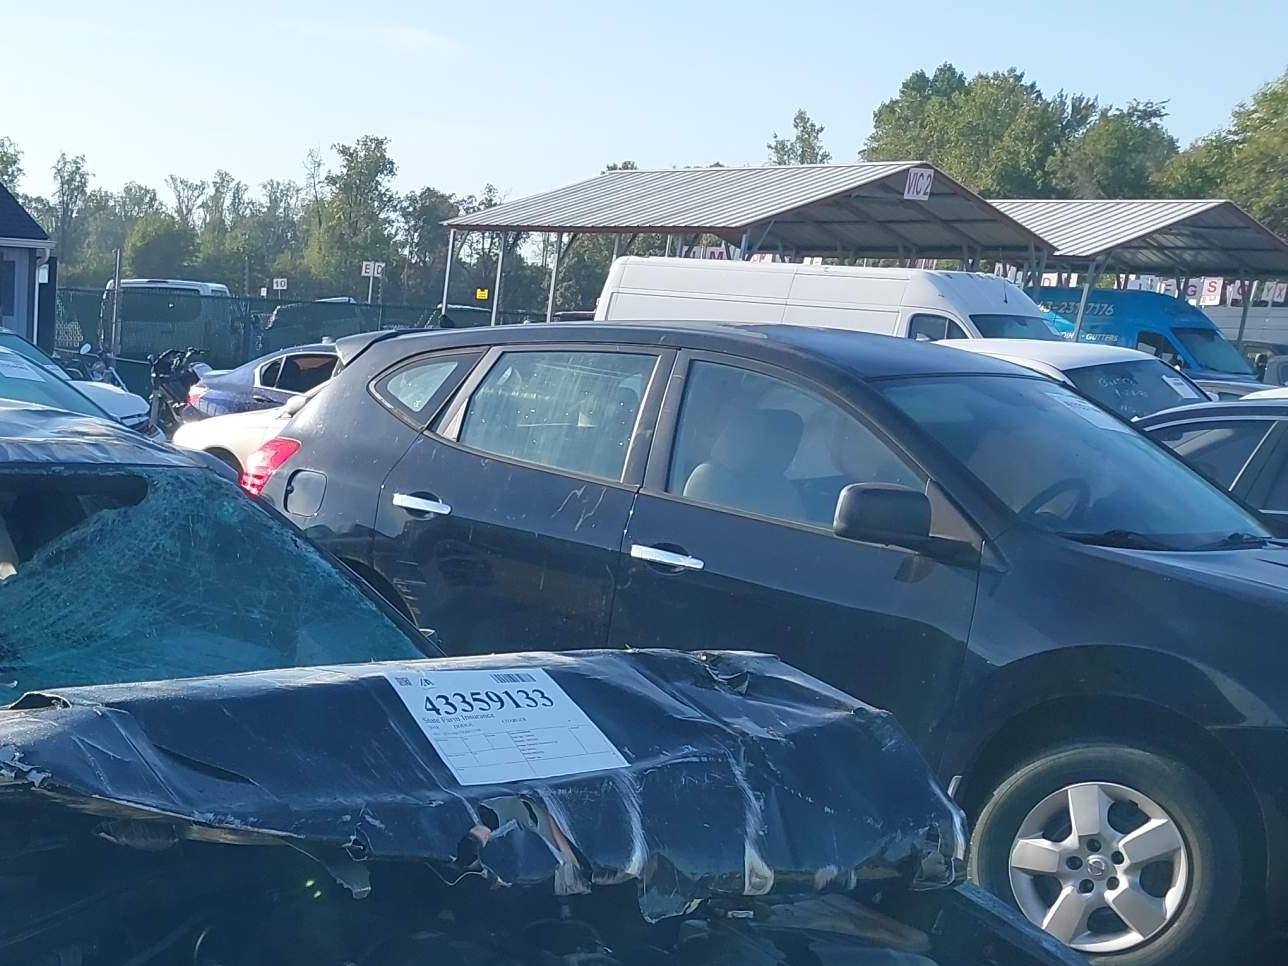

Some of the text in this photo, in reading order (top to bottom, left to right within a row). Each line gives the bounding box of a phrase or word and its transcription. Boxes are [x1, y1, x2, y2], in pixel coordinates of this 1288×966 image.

[907, 172, 932, 195] VIC 2
[275, 280, 286, 289] 10
[1186, 284, 1197, 296] G
[1207, 281, 1218, 293] S
[424, 688, 554, 716] 43359133
[441, 715, 461, 724] Farm
[460, 712, 496, 721] Insurance
